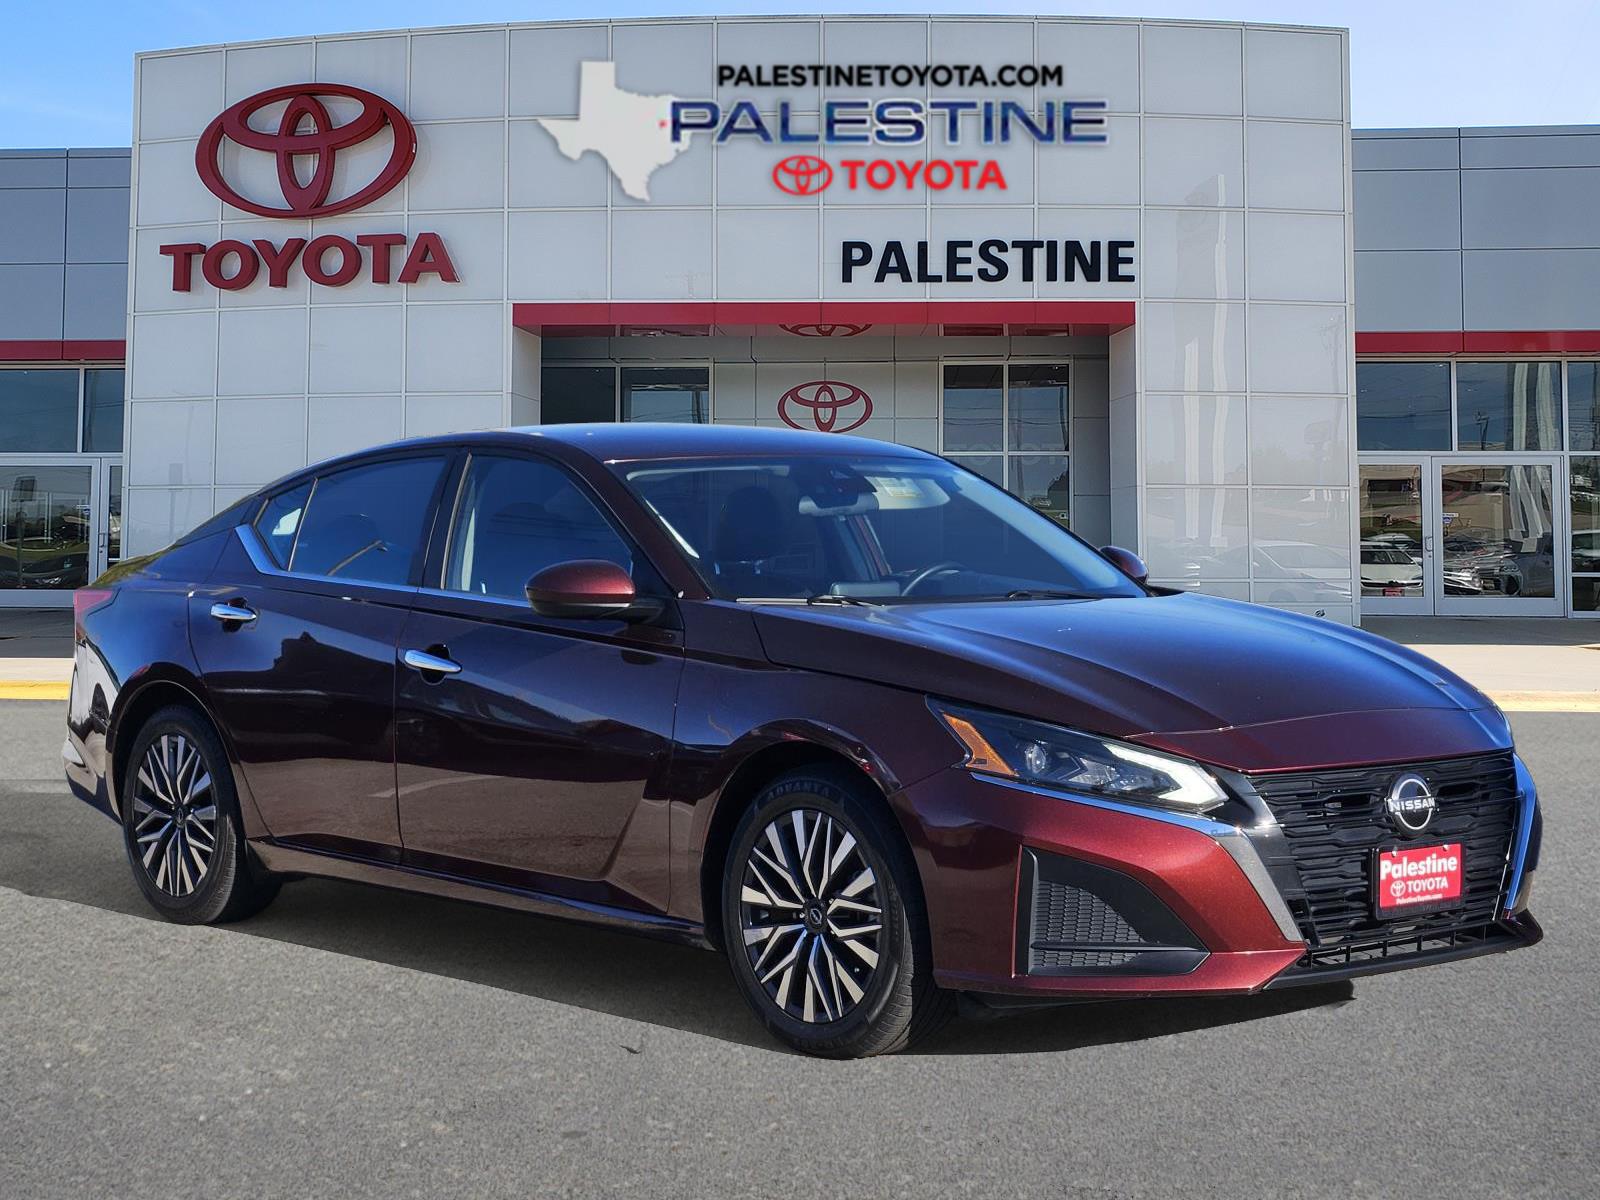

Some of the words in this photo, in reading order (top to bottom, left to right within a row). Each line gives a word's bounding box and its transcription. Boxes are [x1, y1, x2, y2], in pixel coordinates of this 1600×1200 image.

[159, 232, 461, 292] TOYOTA
[842, 240, 1136, 283] PALESTINE
[1388, 797, 1436, 812] NISSAN
[1380, 853, 1458, 880] Palestine
[1407, 876, 1449, 893] TOYOTA
